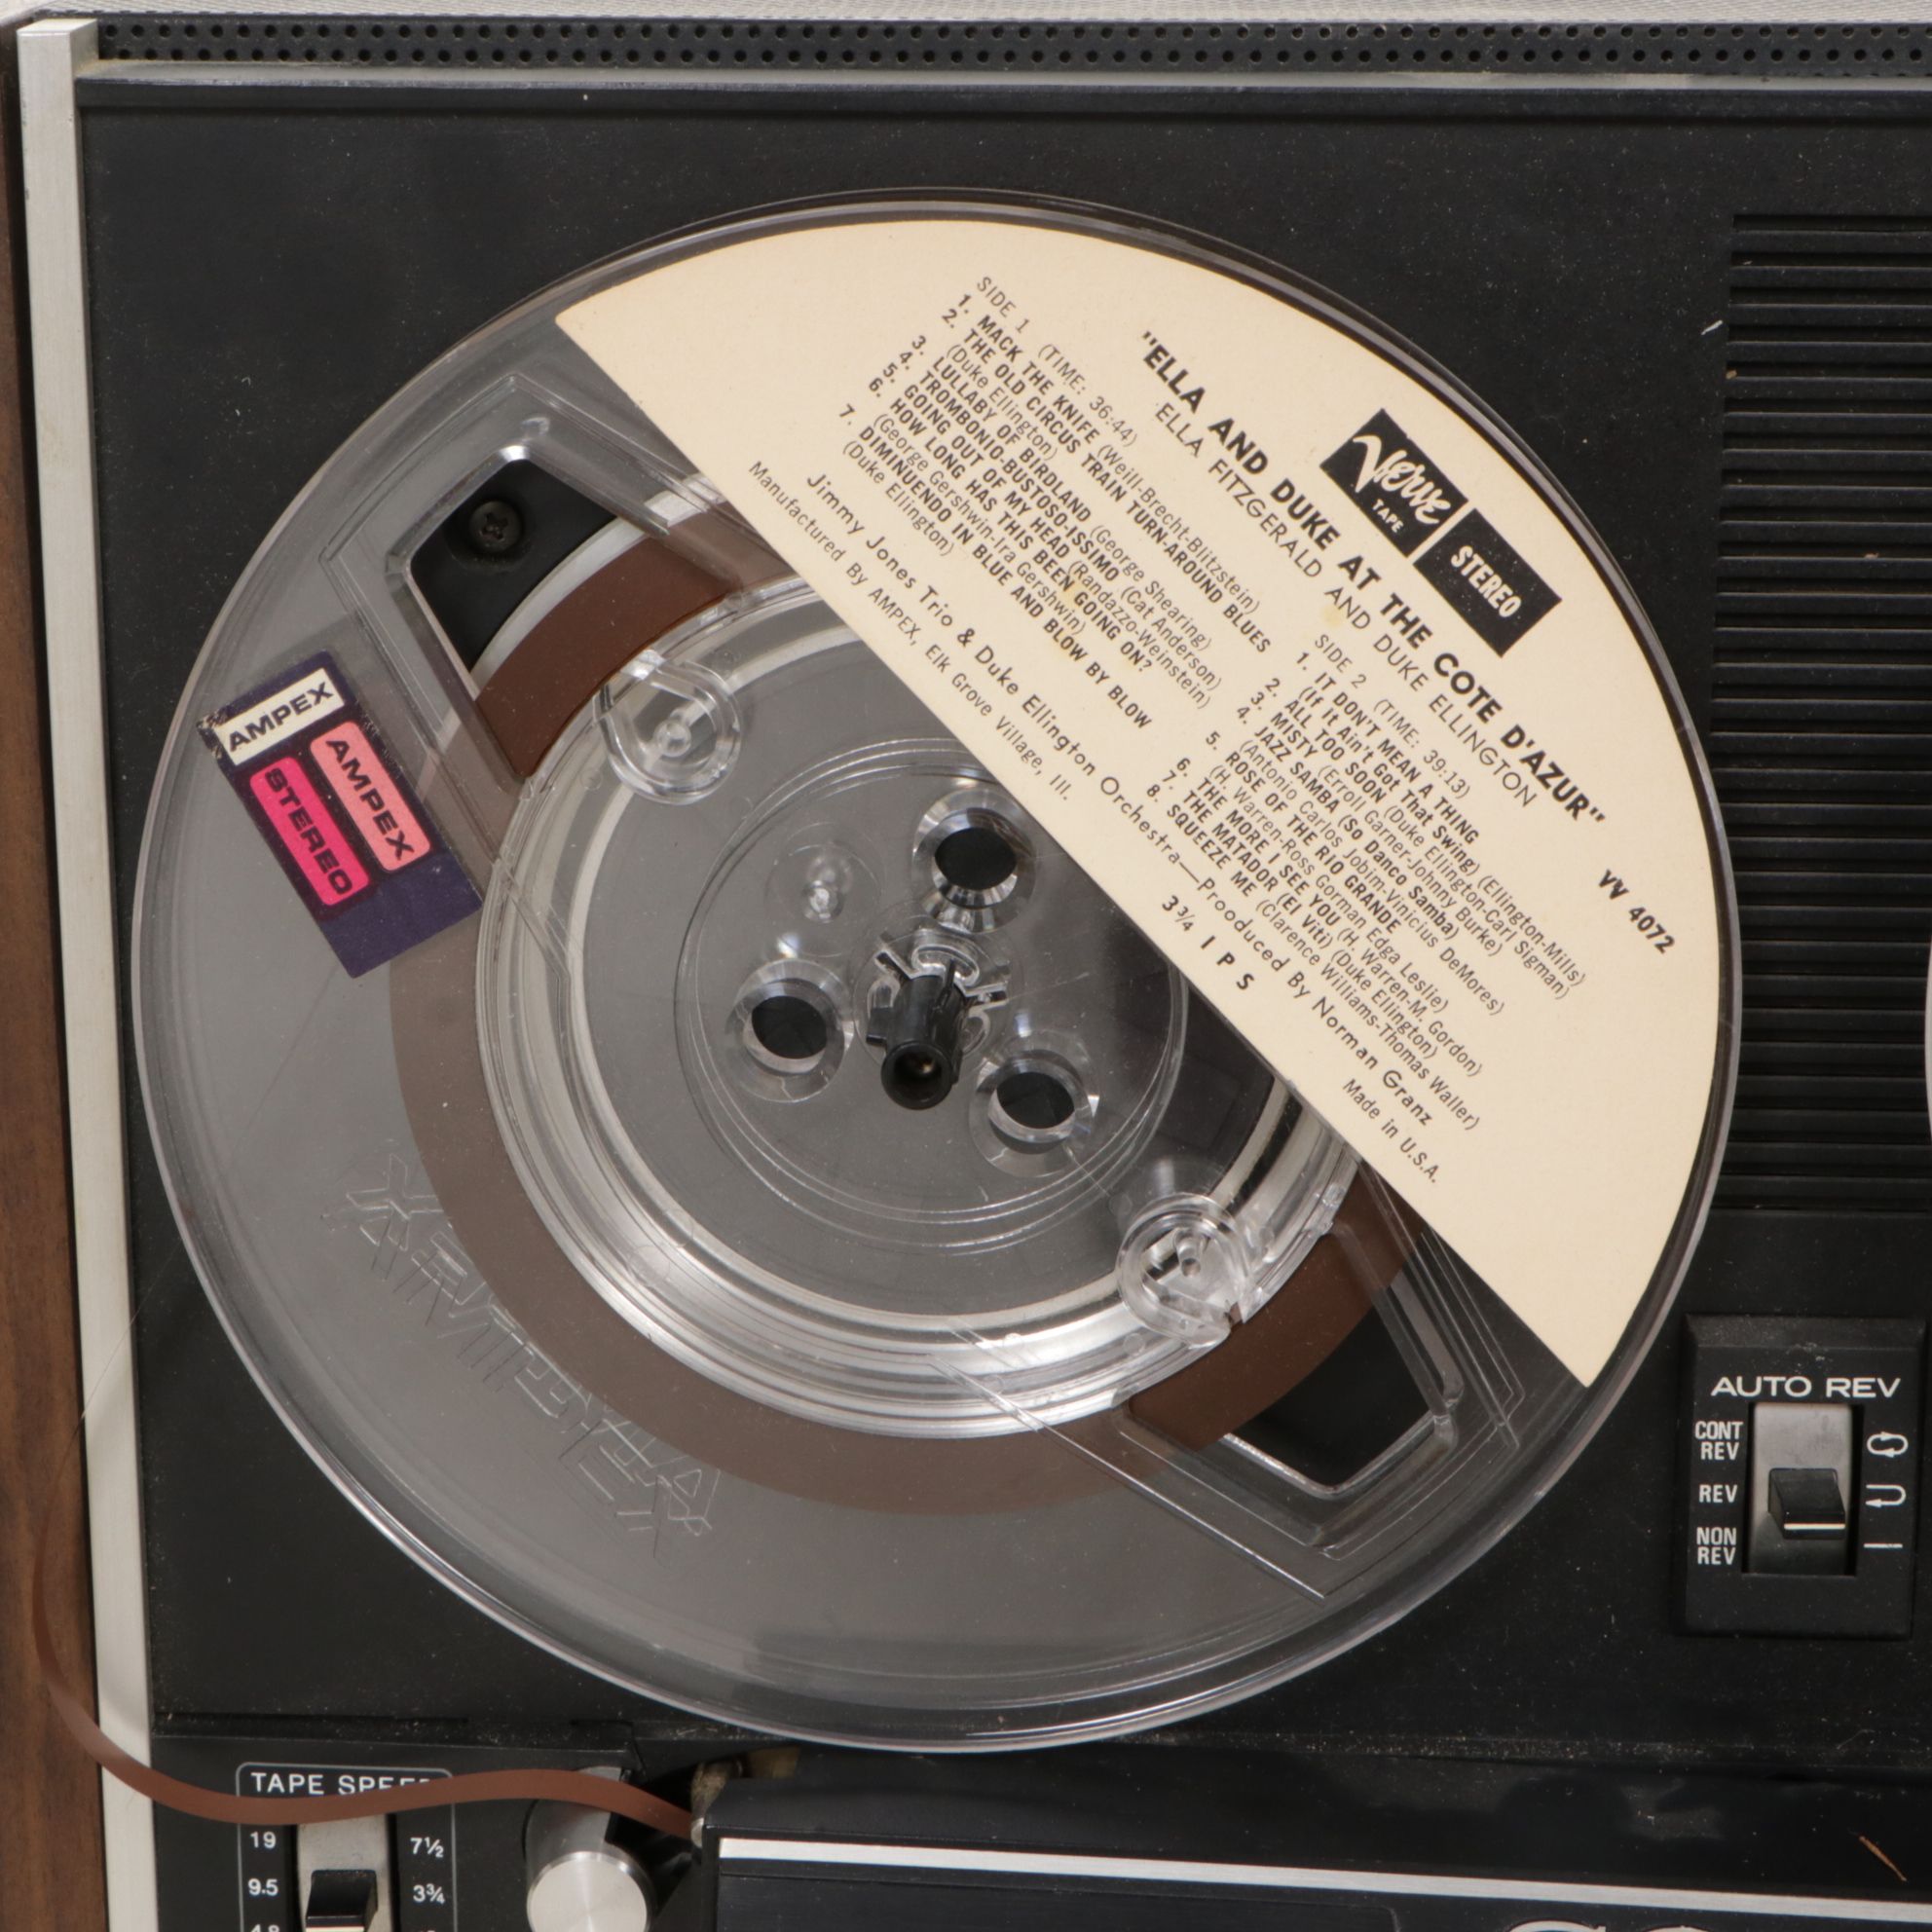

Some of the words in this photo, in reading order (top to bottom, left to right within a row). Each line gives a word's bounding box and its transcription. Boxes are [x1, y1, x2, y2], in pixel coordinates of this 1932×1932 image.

[945, 343, 988, 389] (Duke
[987, 385, 1058, 461] Ellington)
[976, 275, 1017, 318] SIDE
[1014, 317, 1029, 334] 1
[1036, 343, 1086, 395] (TIME:
[1088, 394, 1137, 446] 36:44)
[888, 396, 927, 436] HOW
[923, 435, 966, 480] LONG
[964, 477, 998, 512] HAS
[996, 509, 1034, 550] THIS
[1031, 547, 1076, 592] BEEN
[1072, 590, 1122, 641] GOING
[1119, 640, 1153, 672] ON?
[903, 383, 951, 435] GOING
[949, 434, 985, 466] OUT
[981, 466, 1007, 489] OF
[1003, 489, 1032, 517] MY
[1028, 515, 1070, 559] HEAD
[1066, 560, 1210, 710] (Randazzo-Weinstein)
[918, 369, 1120, 581] TROMBONIO-BUSTOSO-ISSIMO
[1119, 584, 1155, 620] (Cat
[1150, 616, 1222, 691] Anderson)
[931, 354, 997, 422] LULLABY
[995, 423, 1022, 445] OF
[1018, 446, 1092, 523] BIRDLAND
[1089, 524, 1145, 582] (George
[1143, 579, 1212, 651] Shearing)
[962, 326, 996, 364] THE
[993, 362, 1026, 395] OLD
[1024, 394, 1082, 454] CIRCUS
[1079, 451, 1128, 502] TRAIN
[1125, 499, 1223, 604] TURN-AROUND
[1221, 602, 1271, 653] BLUES
[976, 313, 1023, 363] MACK
[1021, 359, 1055, 396] THE
[1051, 393, 1100, 445] KNIFE
[1096, 443, 1260, 614] (Weill-Brecht-Blitzstein)
[1372, 499, 1403, 533] TAPE
[747, 460, 847, 562] Manufactured
[844, 561, 869, 586] By
[867, 586, 921, 647] AMPEX,
[923, 643, 951, 674] Elk
[950, 671, 992, 717] Grove
[994, 714, 1043, 776] Village,
[1048, 772, 1072, 800] Ill.
[857, 425, 952, 523] DIMINUENDO
[950, 521, 975, 545] IN
[970, 541, 1014, 587] BLUE
[1009, 584, 1044, 618] AND
[1041, 616, 1089, 662] BLOW
[1084, 660, 1111, 686] BY
[1106, 683, 1153, 729] BLOW
[1140, 329, 1207, 415] "ELLA
[1206, 416, 1269, 475] AND
[1268, 476, 1341, 551] DUKE
[1335, 553, 1383, 591] AT
[1378, 590, 1433, 650] THE
[1431, 650, 1504, 724] COTE
[1499, 723, 1606, 823] D'AZUR"
[1154, 401, 1205, 459] ELLA
[1207, 457, 1322, 577] FITZGERALD
[1322, 585, 1371, 630] AND
[1371, 632, 1430, 692] DUKE
[1427, 691, 1538, 808] ELLINGTON
[1451, 545, 1522, 617] STEREO
[230, 682, 333, 752] AMPEX
[326, 739, 415, 861] AMPEX
[805, 472, 866, 535] Jimmy
[864, 535, 916, 589] Jones
[918, 583, 953, 627] Trio
[955, 626, 976, 649] &
[973, 643, 1020, 695] Duke
[1021, 692, 1096, 777] Ellington
[1285, 969, 1312, 999] By
[1310, 994, 1379, 1070] Norman
[1381, 1068, 1432, 1127] Granz
[1313, 670, 1337, 691] IT
[1331, 690, 1382, 737] DON'T
[1375, 736, 1422, 784] MEAN
[1417, 782, 1434, 799] A
[1432, 795, 1479, 845] THING
[1314, 632, 1353, 674] SIDE
[1350, 672, 1367, 689] 2
[1372, 697, 1420, 749] (TIME:
[1422, 748, 1470, 799] 39:13)
[265, 768, 353, 895] STEREO
[1223, 749, 1266, 794] ROSE
[1263, 791, 1288, 813] OF
[1285, 812, 1319, 847] THE
[1313, 843, 1345, 875] RIO
[1343, 873, 1402, 935] GRANDE
[1252, 724, 1292, 762] JAZZ
[1288, 761, 1341, 814] SAMBA
[1336, 813, 1364, 840] (So
[1406, 884, 1460, 941] Samba)
[1269, 710, 1319, 759] MISTY
[1317, 764, 1367, 812] (Erroll
[1362, 808, 1457, 909] Garner-Johnny
[1454, 905, 1504, 957] Burke)
[1282, 698, 1313, 729] ALL
[1313, 726, 1346, 762] TOO
[1343, 761, 1388, 804] SOON
[1382, 804, 1425, 847] (Duke
[1423, 844, 1518, 943] Ellington-Carl
[1512, 939, 1570, 1000] Sigman)
[1297, 685, 1324, 708] (If
[1319, 706, 1340, 727] It
[1335, 724, 1375, 764] Ain't
[1372, 762, 1401, 793] Got
[1399, 788, 1434, 827] That
[1430, 823, 1480, 876] Swing)
[1475, 873, 1586, 987] (Ellington-Mills)
[1165, 802, 1232, 870] SQUEEZE
[1229, 869, 1258, 898] ME
[1254, 898, 1320, 966] (Clarence
[1319, 961, 1430, 1080] Williams-Thomas
[1428, 1074, 1480, 1131] Waller)
[1181, 788, 1213, 824] THE
[1210, 821, 1279, 893] MATADOR
[1275, 891, 1303, 915] (El
[1300, 912, 1333, 949] Viti)
[1329, 948, 1372, 991] (Duke
[1369, 987, 1438, 1059] Ellington)
[1196, 775, 1228, 811] THE
[1224, 807, 1270, 854] MORE
[1278, 863, 1311, 896] SEE
[1308, 892, 1341, 927] YOU
[1335, 926, 1359, 951] (H.
[1359, 947, 1428, 1022] Warren-M.
[1427, 1019, 1483, 1077] Gordon)
[1627, 905, 1676, 955] 4072
[1341, 1077, 1381, 1120] Made
[1380, 1117, 1399, 1139] in
[1398, 1135, 1439, 1184] U.S.A.
[1694, 1420, 1744, 1440] CONT
[1700, 1440, 1740, 1461] REV
[1710, 1375, 1812, 1398] AUTO
[1825, 1377, 1901, 1398] REV
[1696, 1526, 1737, 1545] NON
[1696, 1545, 1736, 1566] REV
[1698, 1484, 1738, 1504] REV
[250, 1771, 324, 1796] TAPE
[338, 1775, 430, 1796] SPE
[250, 1831, 277, 1849] 19
[247, 1877, 279, 1897] 9.5
